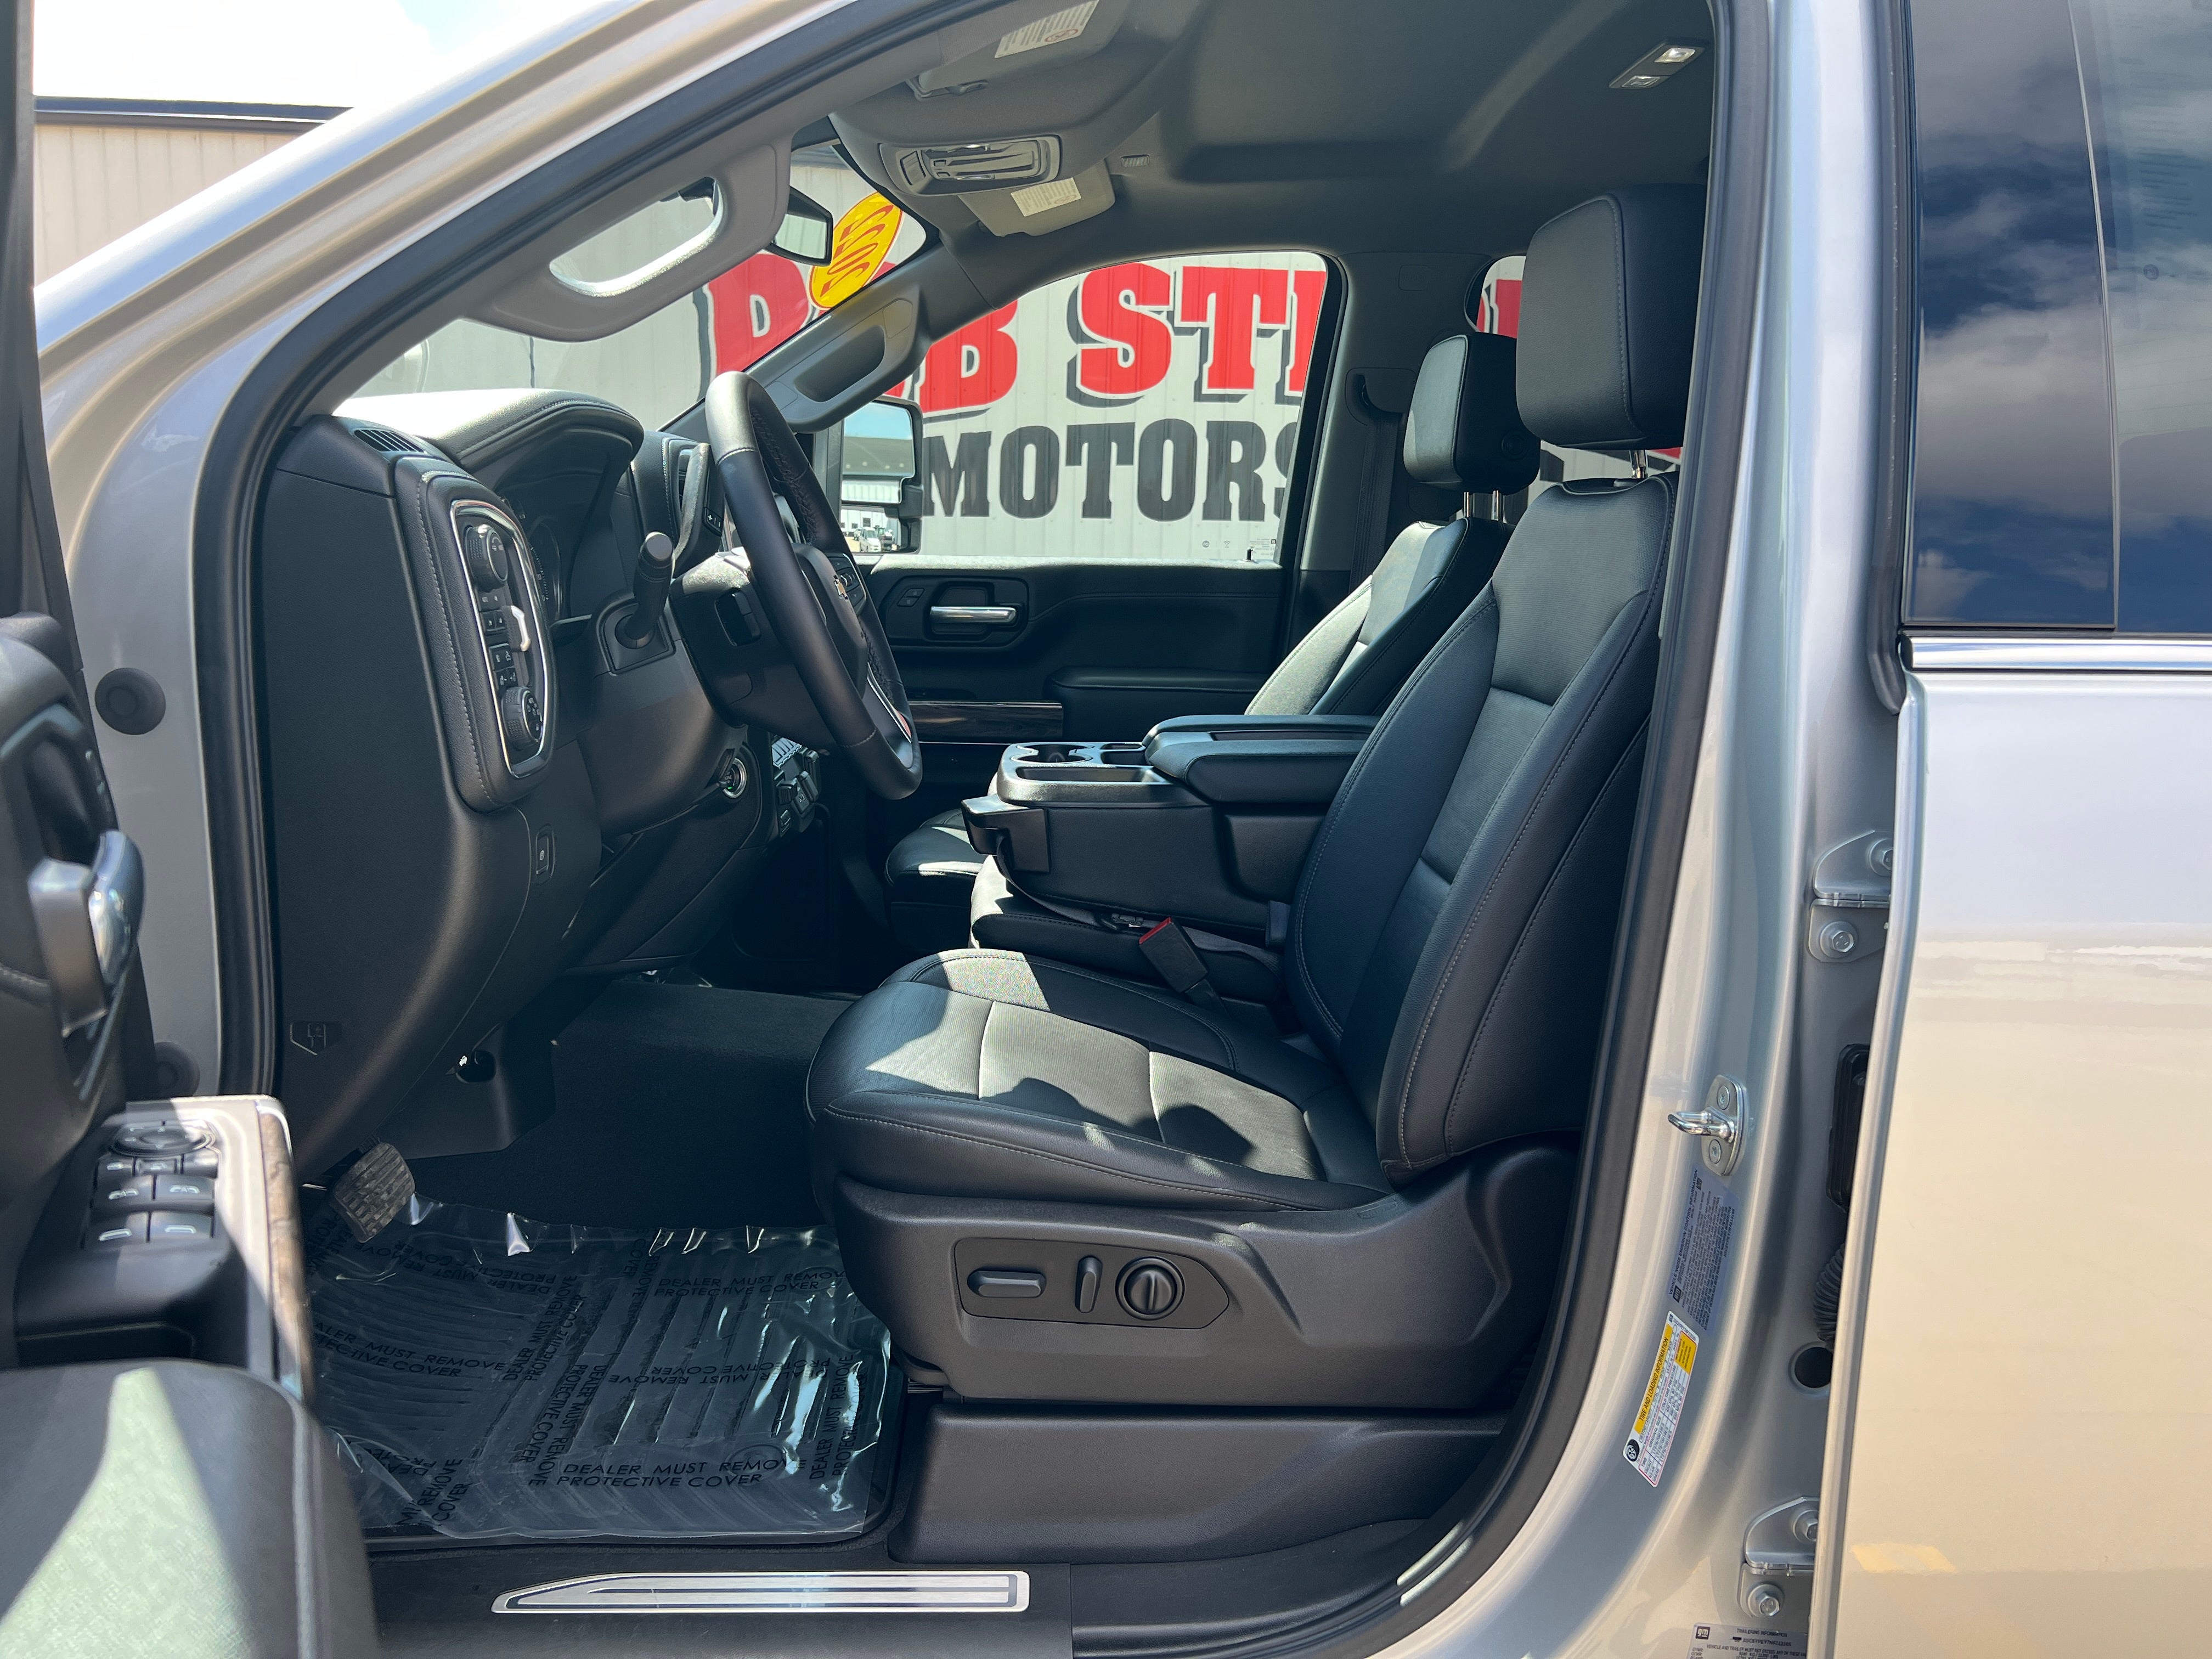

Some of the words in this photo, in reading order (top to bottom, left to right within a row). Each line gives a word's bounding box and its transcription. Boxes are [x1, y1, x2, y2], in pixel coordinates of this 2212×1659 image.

[923, 419, 1297, 522] MOTOR
[1689, 1169, 1699, 1205] INFORMATION
[654, 1286, 754, 1296] PROTECTIVE
[760, 1281, 819, 1293] COVER
[658, 1278, 721, 1287] DEALER
[731, 1274, 775, 1285] MUST
[784, 1270, 847, 1280] REMOV
[315, 1322, 357, 1344] ALER
[365, 1341, 417, 1359] MUST
[424, 1353, 508, 1371] REMOVE
[392, 1359, 462, 1376] COVER
[607, 1374, 689, 1384] REMOVE
[651, 1365, 717, 1375] COVER
[699, 1373, 748, 1384] MUST
[830, 1354, 854, 1400] REMOVE
[1647, 1372, 1658, 1398] LOADING
[1654, 1336, 1669, 1374] INFORMATION
[559, 1402, 588, 1429] MUST
[822, 1406, 842, 1432] MUST
[563, 1463, 641, 1475] DEALER
[653, 1462, 707, 1475] MUST
[809, 1437, 834, 1480] DEALER
[417, 1458, 464, 1506] REMOVE
[556, 1475, 681, 1487] PROTECTIVE
[687, 1473, 763, 1488] COVER
[431, 1482, 474, 1521] COVER
